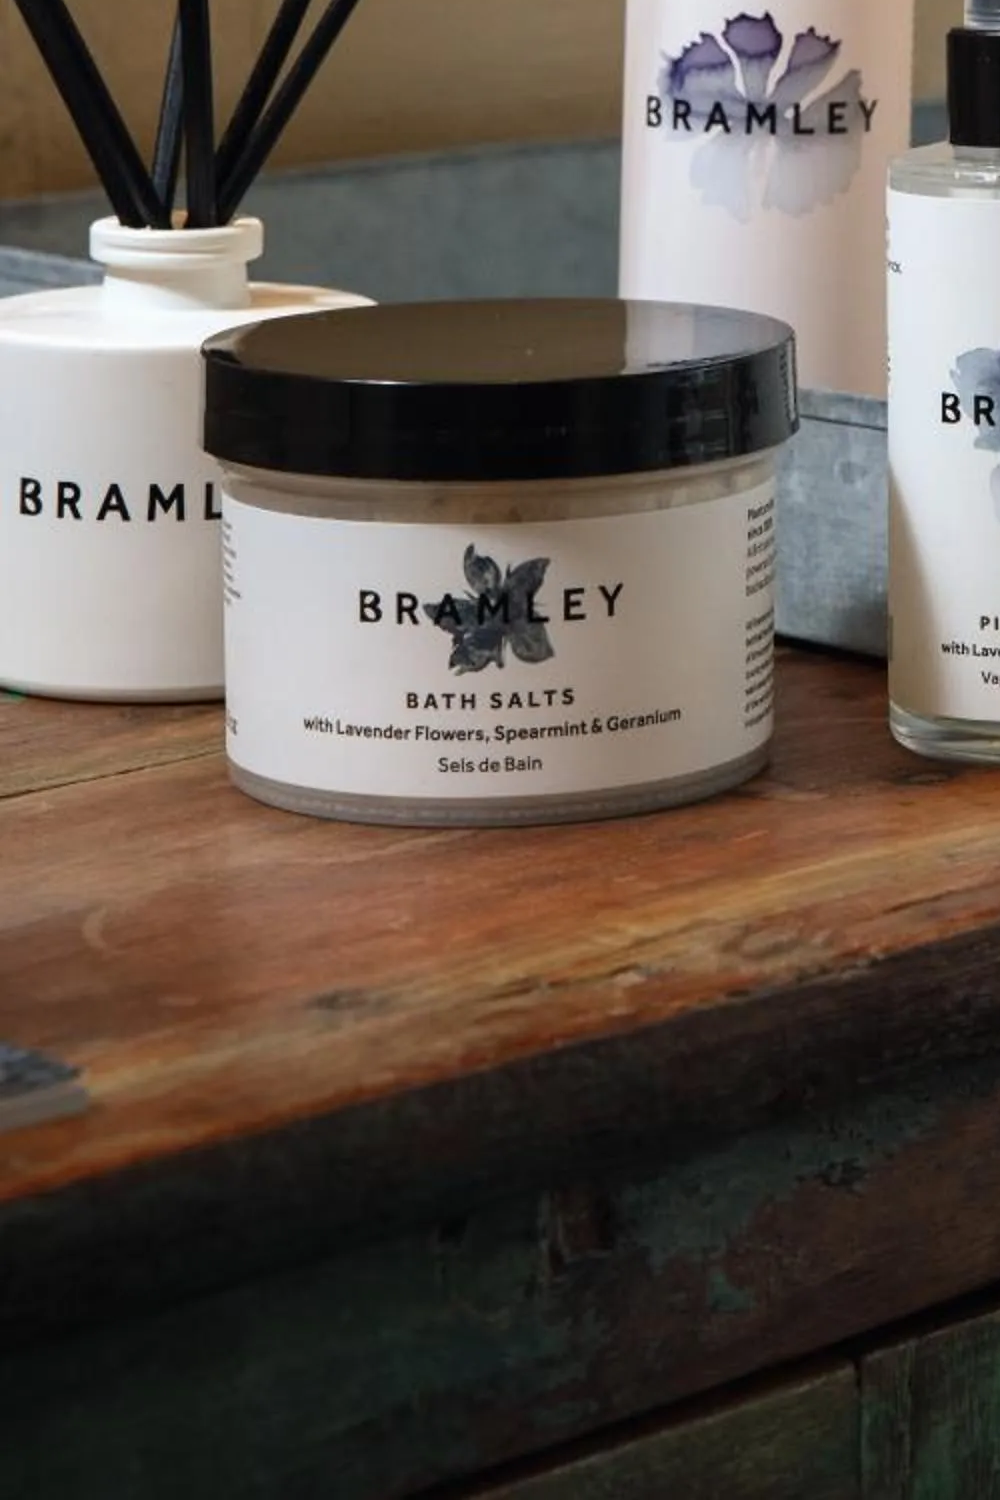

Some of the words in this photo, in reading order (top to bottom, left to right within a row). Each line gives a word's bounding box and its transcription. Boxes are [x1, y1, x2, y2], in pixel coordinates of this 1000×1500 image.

[646, 95, 879, 137] BRAMLEY
[19, 476, 222, 522] BRAML
[359, 583, 625, 626] BRAMLEY
[942, 641, 970, 656] with
[406, 692, 476, 710] BATH
[490, 688, 576, 710] SALTS
[303, 716, 333, 735] with
[336, 719, 411, 741] Lavender
[415, 725, 490, 744] Flowers,
[495, 721, 588, 744] Spearmint
[591, 718, 602, 734] &
[607, 708, 682, 732] Geranium
[438, 757, 475, 773] Sels
[479, 757, 501, 773] de
[505, 755, 543, 773] Bain
